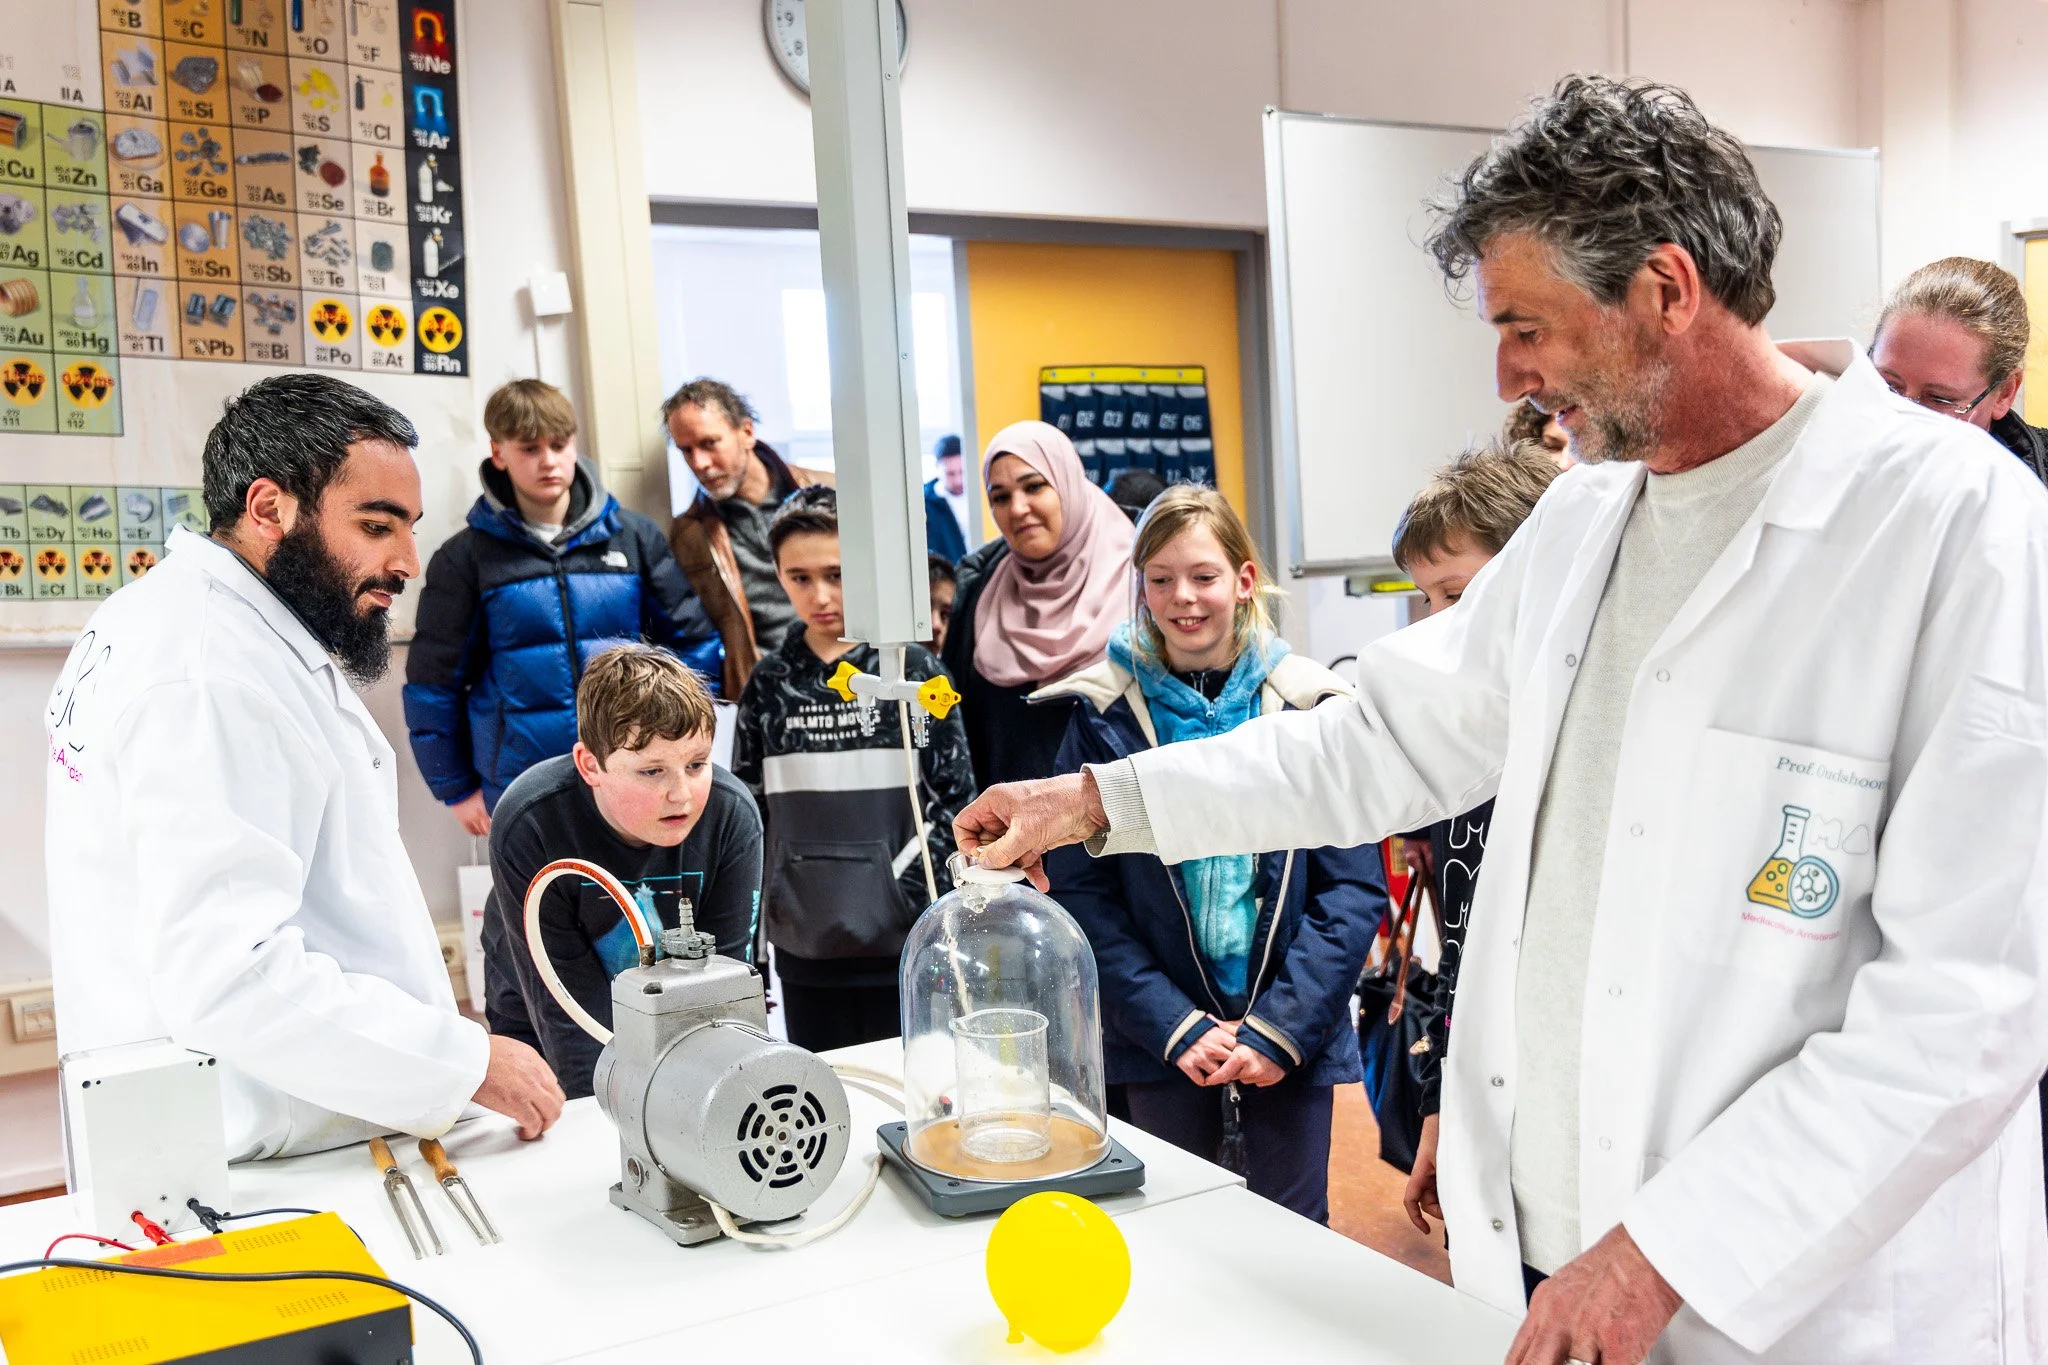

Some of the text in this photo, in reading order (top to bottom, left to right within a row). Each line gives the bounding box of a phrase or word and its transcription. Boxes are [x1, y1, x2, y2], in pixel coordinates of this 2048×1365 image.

[128, 12, 142, 28] B
[785, 12, 794, 27] 9
[190, 22, 204, 39] C
[252, 30, 268, 47] N
[313, 38, 329, 54] O
[370, 46, 381, 62] F
[425, 55, 451, 75] Ne
[133, 94, 153, 112] Al
[195, 101, 214, 119] Si
[257, 108, 271, 124] P
[318, 116, 332, 133] S
[374, 123, 391, 141] Cl
[428, 132, 450, 150] Ar
[7, 160, 35, 179] Cu
[72, 168, 98, 187] Zn
[136, 175, 164, 193] Ga
[200, 181, 228, 198] Ge
[263, 188, 287, 205] As
[322, 194, 345, 211] Se
[377, 201, 396, 217] Br
[432, 207, 453, 225] Kr
[12, 245, 40, 268] Ag
[76, 250, 104, 269] Cd
[141, 256, 159, 273] In
[204, 260, 232, 278] Sn
[267, 265, 292, 284] Sb
[327, 271, 345, 288] Te
[435, 280, 460, 299] Xe
[18, 327, 44, 346] Au
[81, 331, 110, 354] Hg
[146, 335, 164, 353] Tl
[208, 339, 235, 357] Pb
[271, 343, 289, 360] Bi
[330, 348, 352, 365] Po
[385, 352, 404, 368] At
[437, 354, 462, 374] Rn
[1076, 410, 1096, 429] 02
[1103, 410, 1124, 429] 03
[1131, 411, 1151, 430] 04
[1159, 412, 1179, 431] 05
[1183, 414, 1204, 432] 06
[2, 526, 21, 539] Tb
[46, 526, 66, 542] Dy
[92, 527, 113, 539] Ho
[137, 527, 153, 539] Er
[5, 585, 24, 597] Bk
[50, 584, 66, 596] Cf
